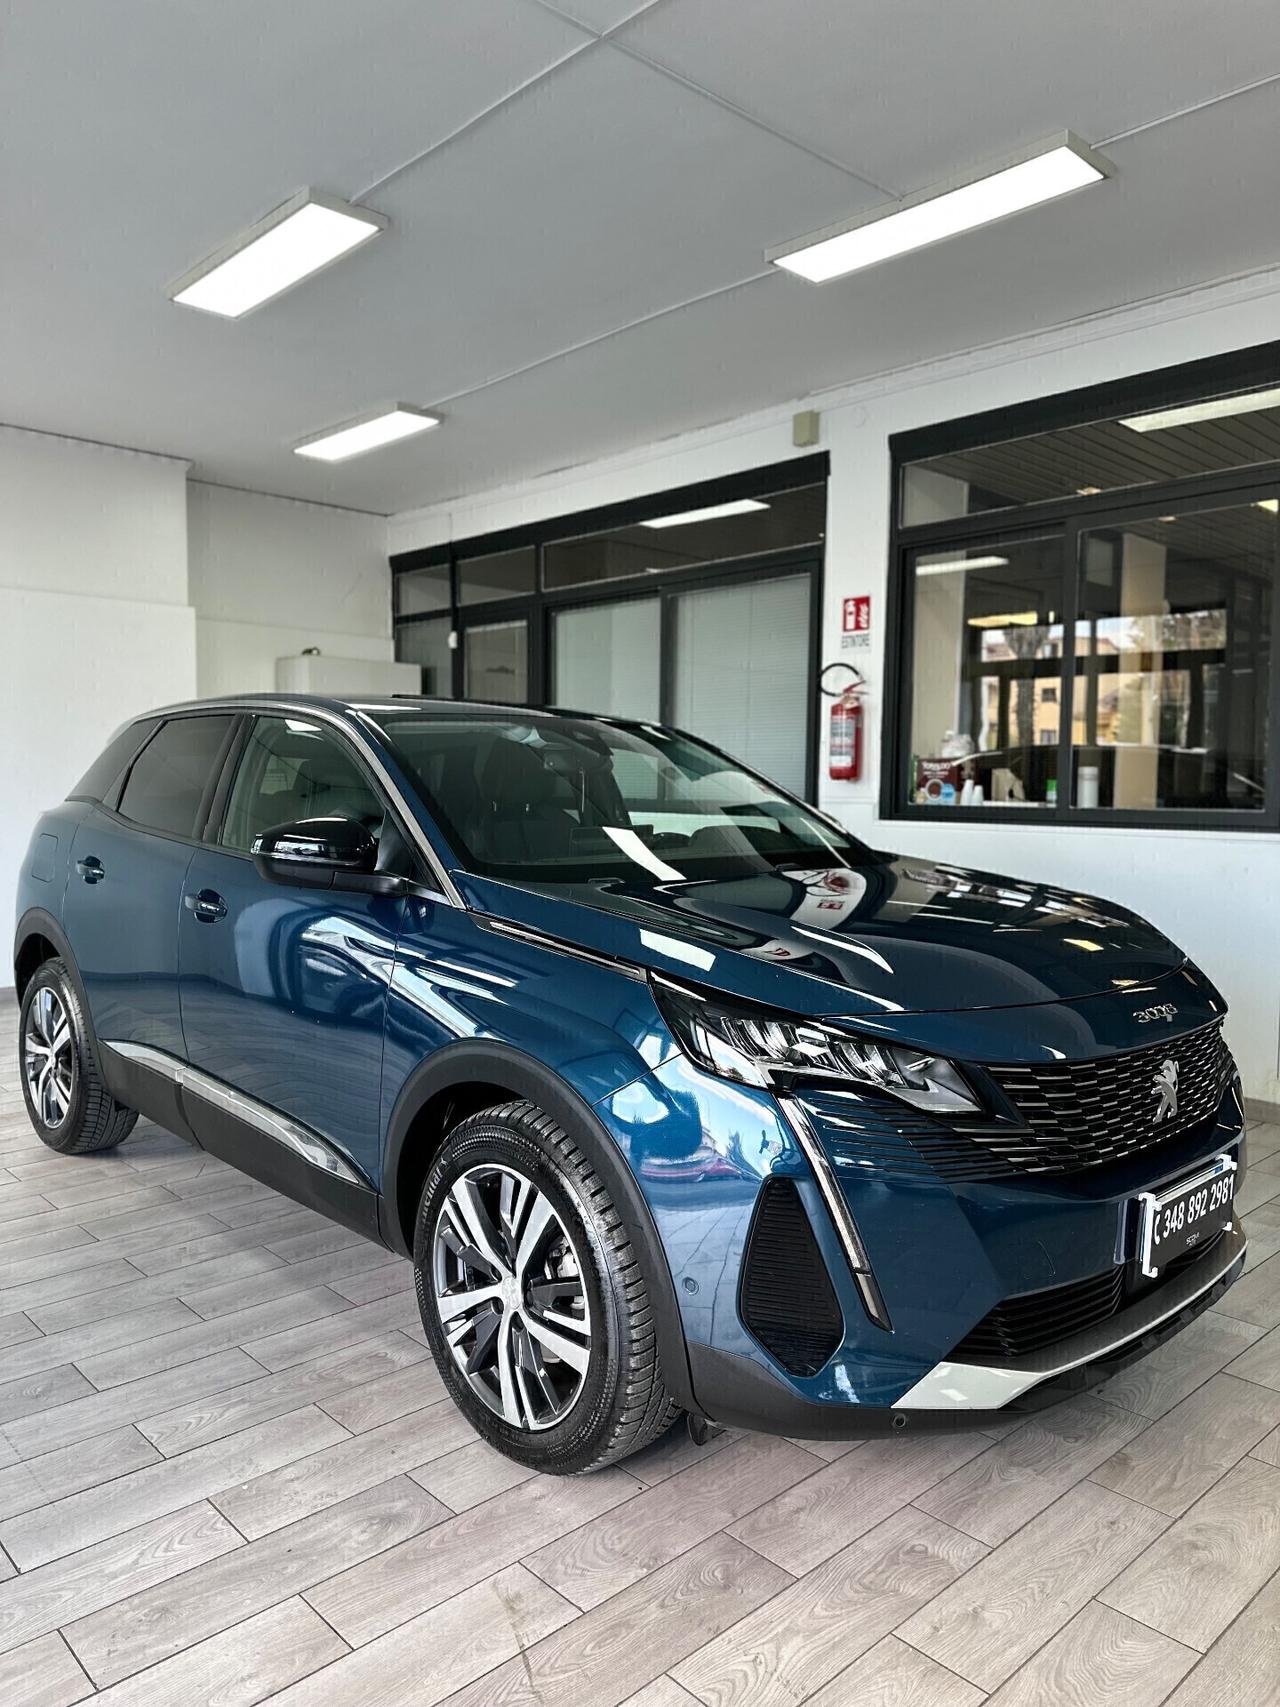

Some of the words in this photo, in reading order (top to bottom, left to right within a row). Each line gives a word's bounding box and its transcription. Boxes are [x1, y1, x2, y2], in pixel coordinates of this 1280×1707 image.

[1162, 1201, 1185, 1238] 348
[1187, 1188, 1208, 1224] 892
[1209, 1173, 1235, 1211] 2981
